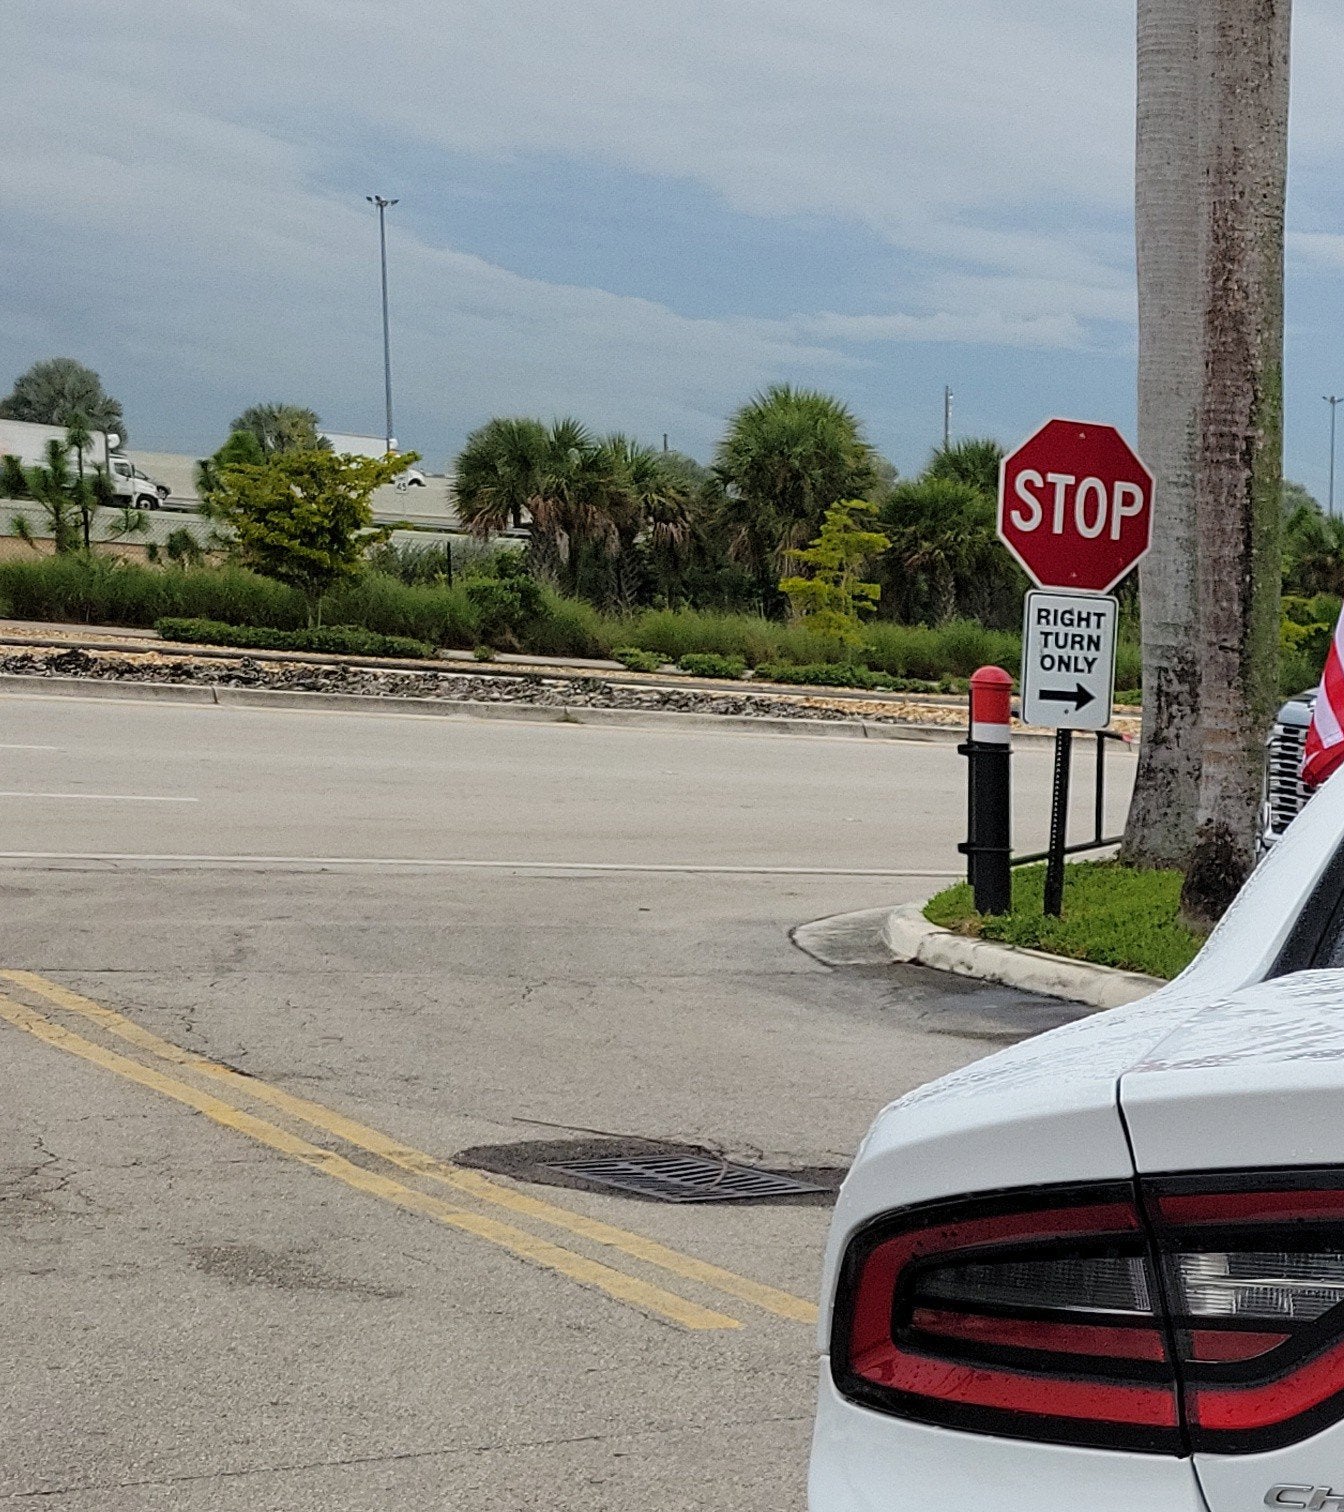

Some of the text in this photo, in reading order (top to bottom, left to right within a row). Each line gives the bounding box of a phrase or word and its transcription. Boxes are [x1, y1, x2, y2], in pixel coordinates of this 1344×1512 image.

[1010, 469, 1144, 541] STOP
[1036, 607, 1107, 630] RIGHT
[1040, 631, 1101, 652] TURN
[1040, 654, 1099, 674] ONLY
